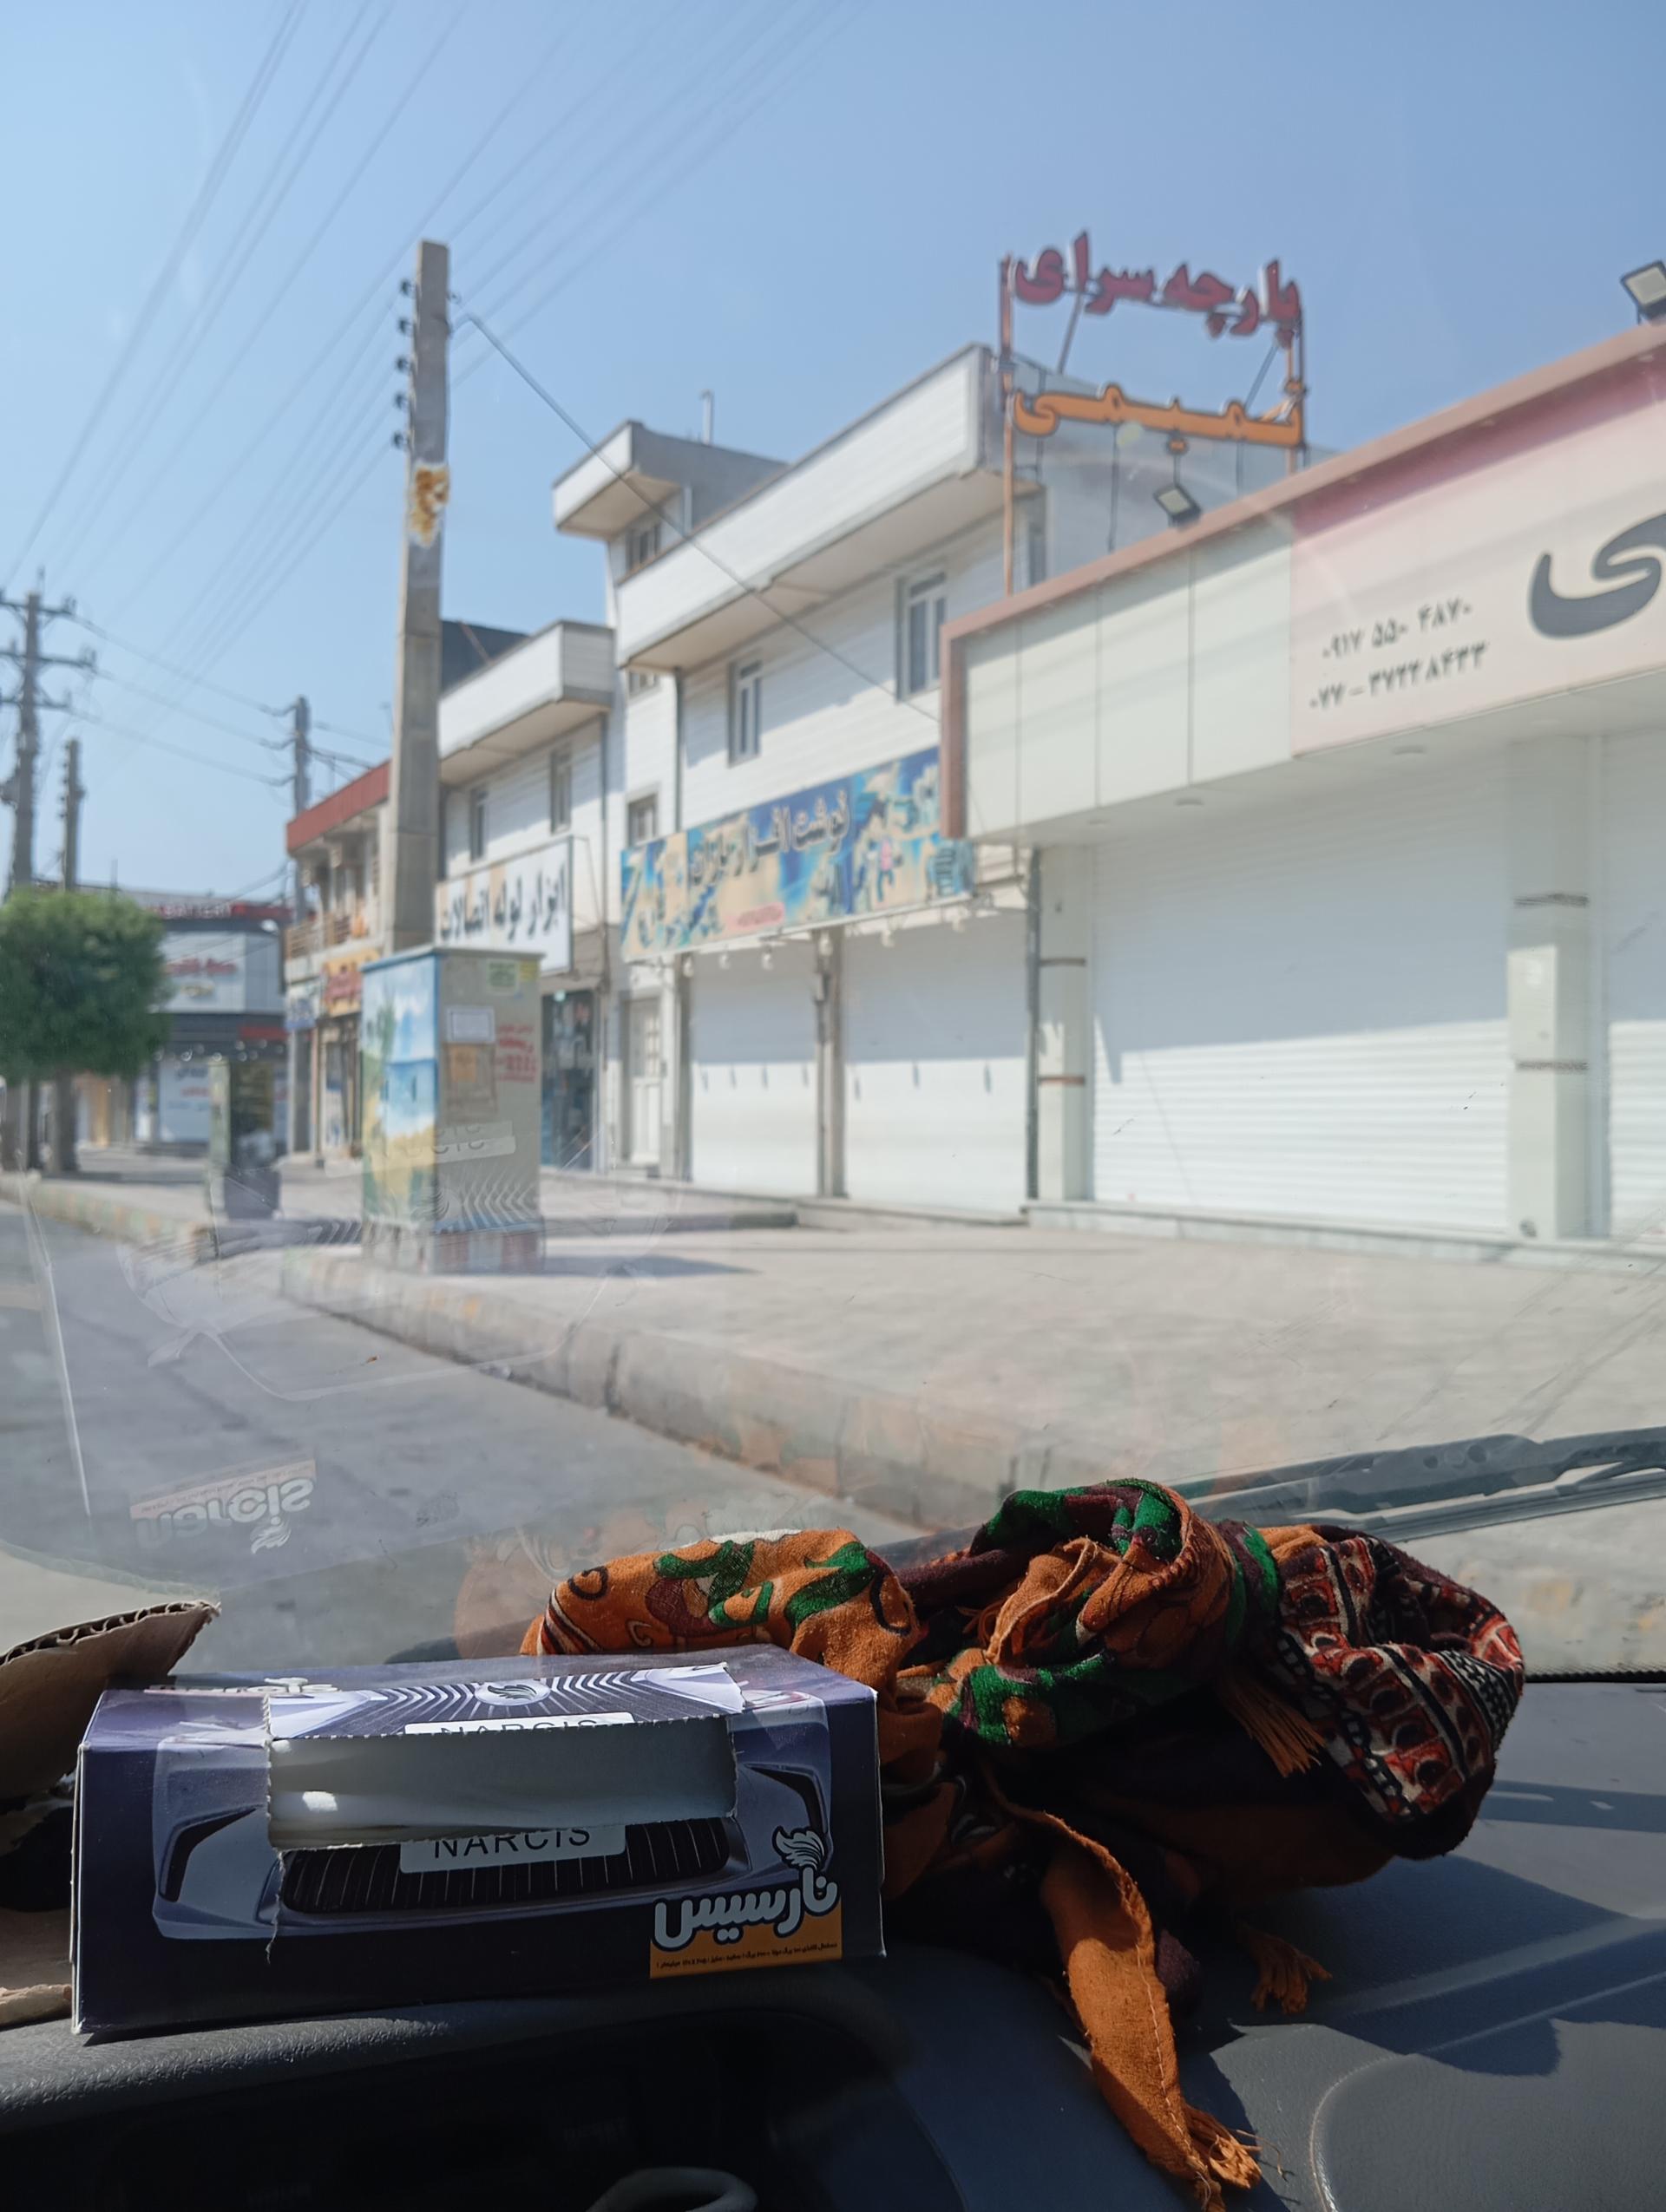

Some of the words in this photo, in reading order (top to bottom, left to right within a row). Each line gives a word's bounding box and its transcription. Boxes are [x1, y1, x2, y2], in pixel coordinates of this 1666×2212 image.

[1014, 230, 1155, 315] سرای
[1163, 259, 1302, 349] پارچه
[434, 1827, 591, 1859] NARCIS
[655, 1867, 838, 1949] نارسیس
